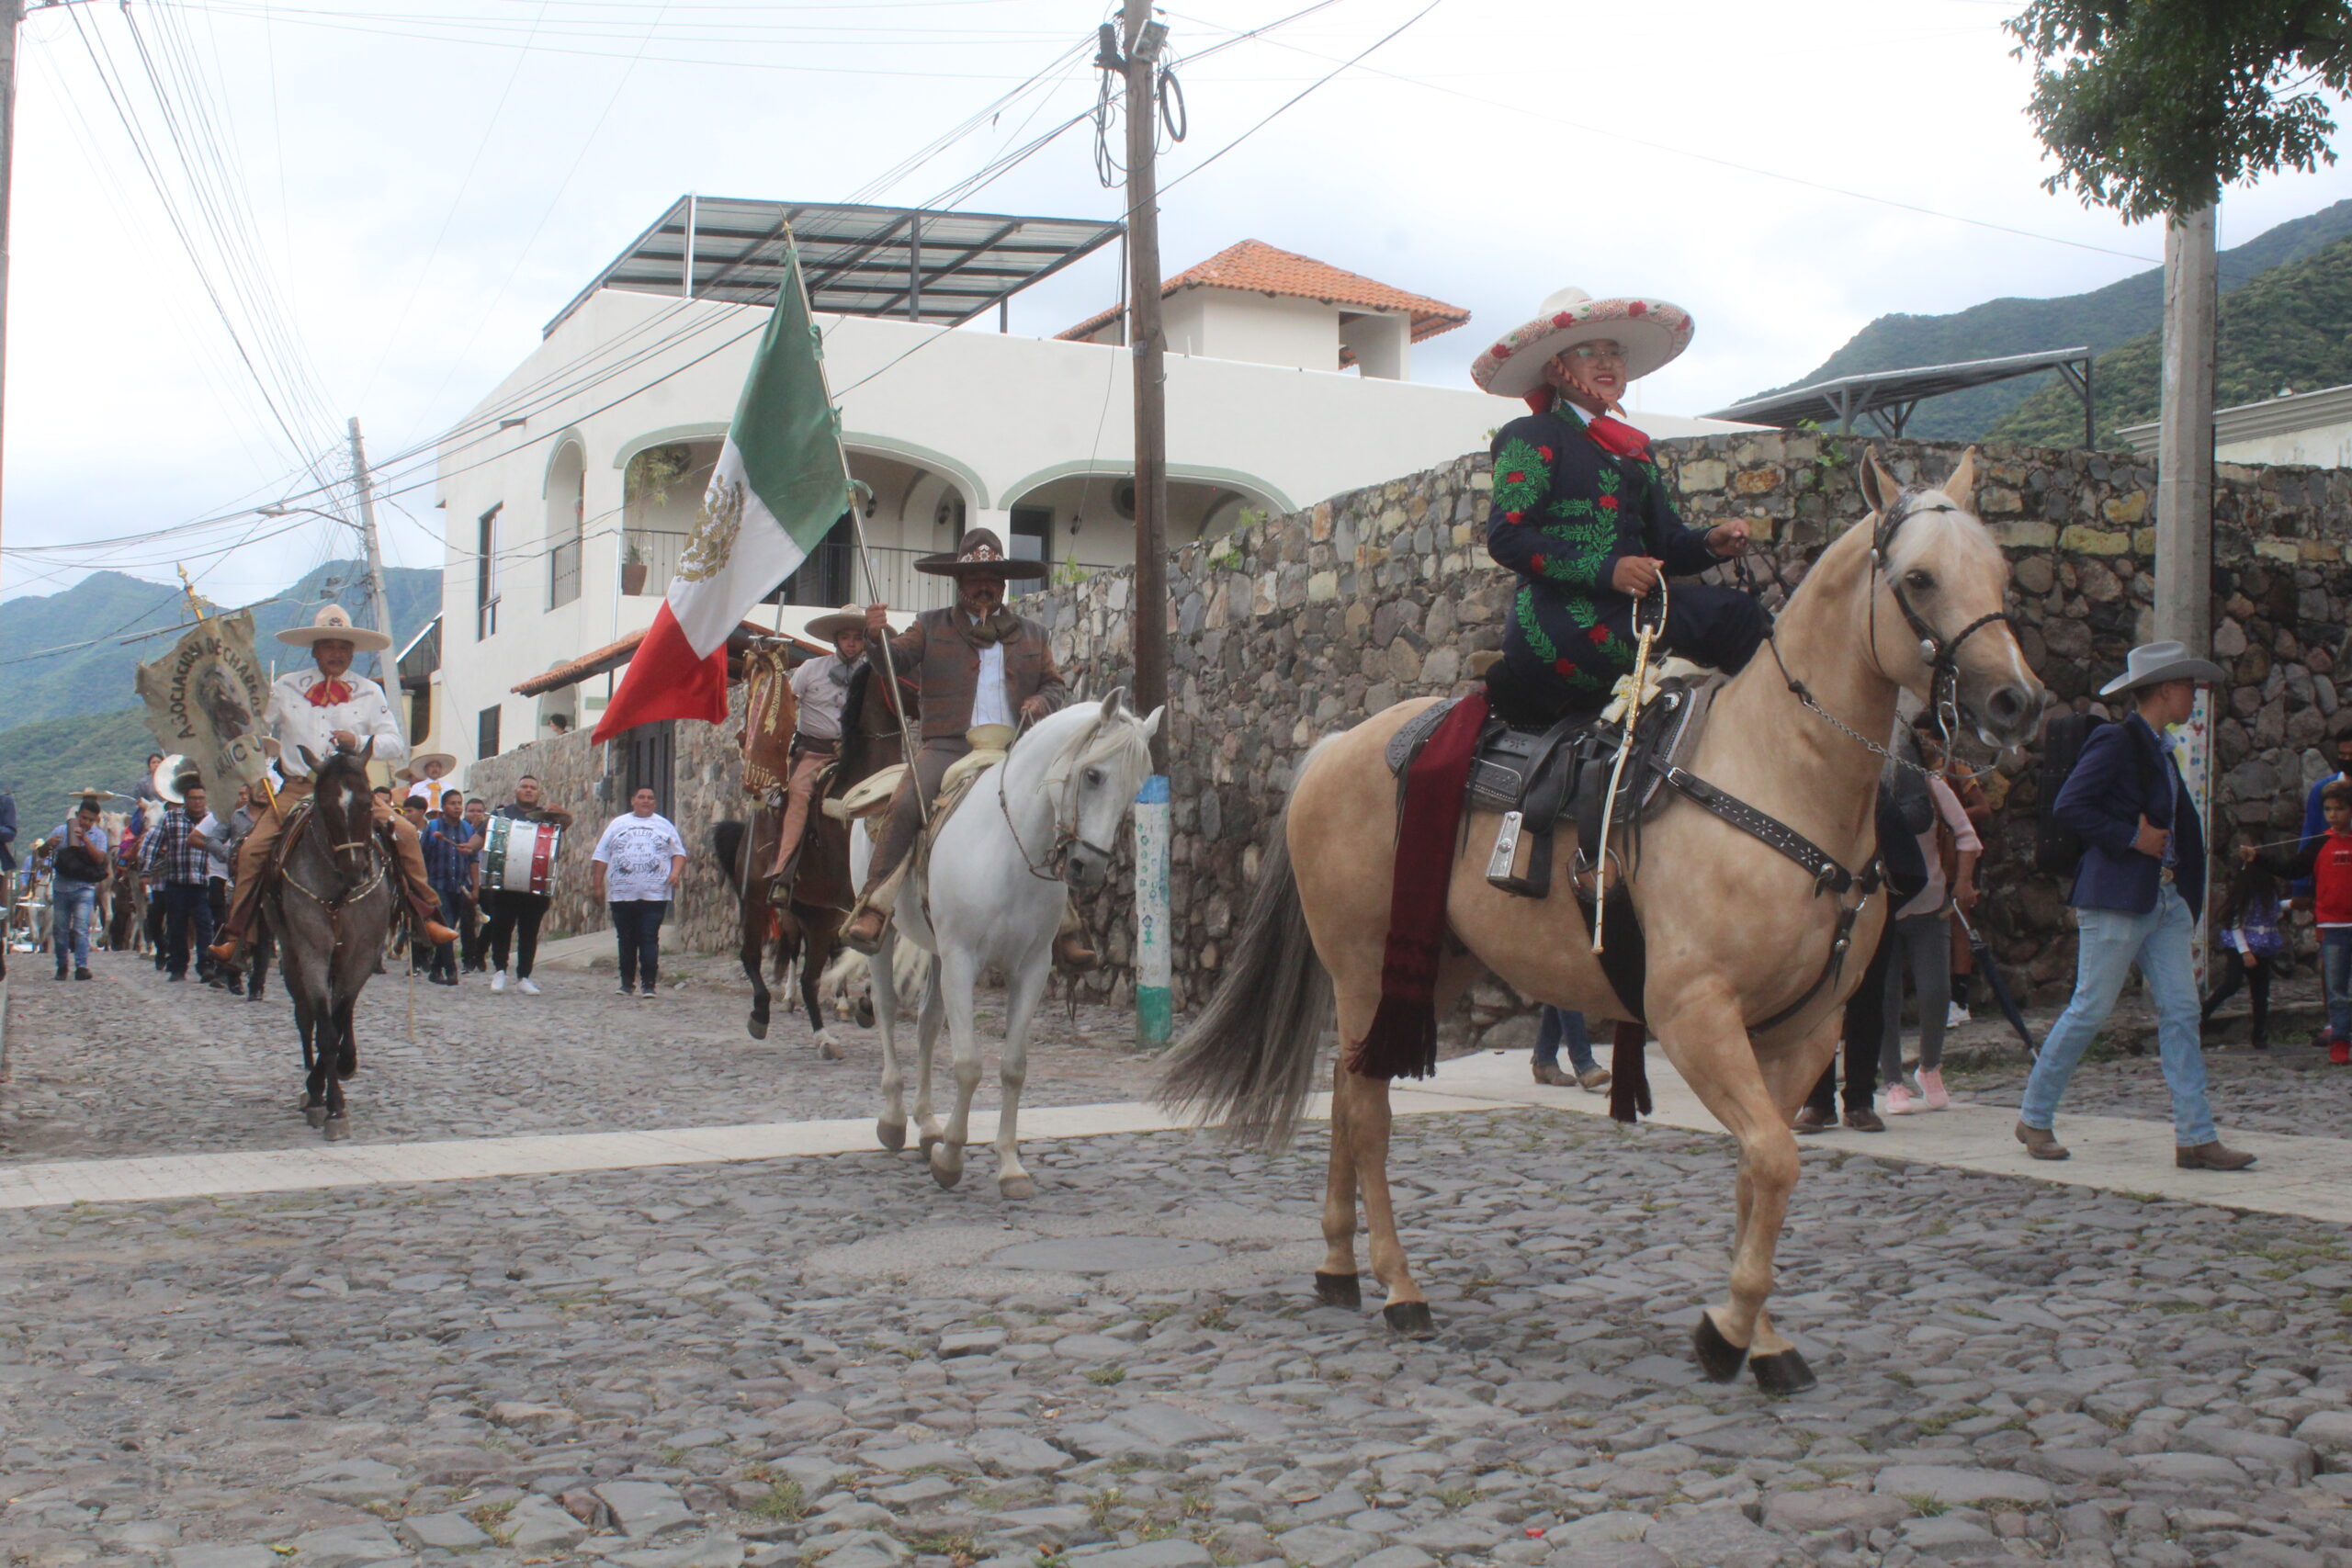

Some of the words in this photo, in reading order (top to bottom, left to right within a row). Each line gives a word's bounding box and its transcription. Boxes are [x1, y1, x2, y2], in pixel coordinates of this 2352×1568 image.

[169, 640, 204, 739] ASOCIACION
[205, 637, 222, 656] DE
[222, 648, 263, 718] CHARROS
